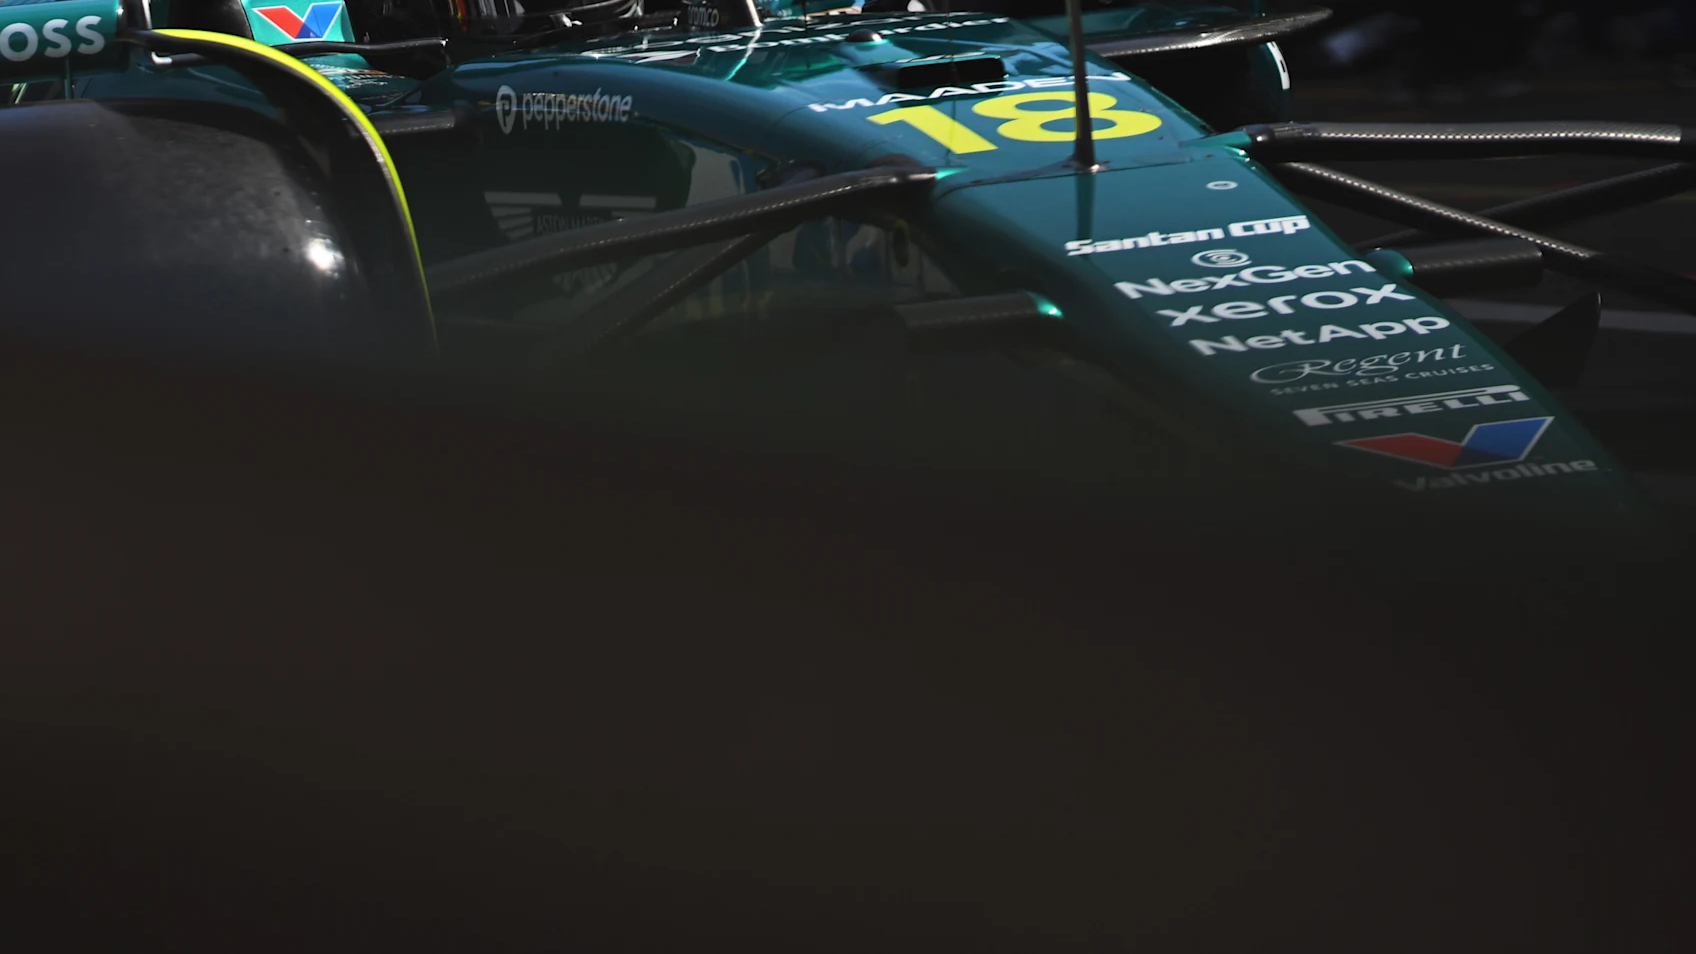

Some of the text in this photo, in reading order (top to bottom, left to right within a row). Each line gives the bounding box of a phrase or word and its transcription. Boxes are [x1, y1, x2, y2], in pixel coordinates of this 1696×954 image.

[522, 87, 633, 131] pepperstone
[865, 91, 1163, 155] 18
[1064, 230, 1226, 257] Santan
[1112, 258, 1377, 300] NexGen
[1155, 283, 1416, 328] xerox
[1188, 314, 1451, 357] NetApp
[1248, 343, 1467, 385] Regent
[1269, 362, 1495, 397] SEVEN SEAS CRUISES
[1291, 383, 1532, 428] PIRELLI
[1392, 458, 1598, 493] Valvoline
